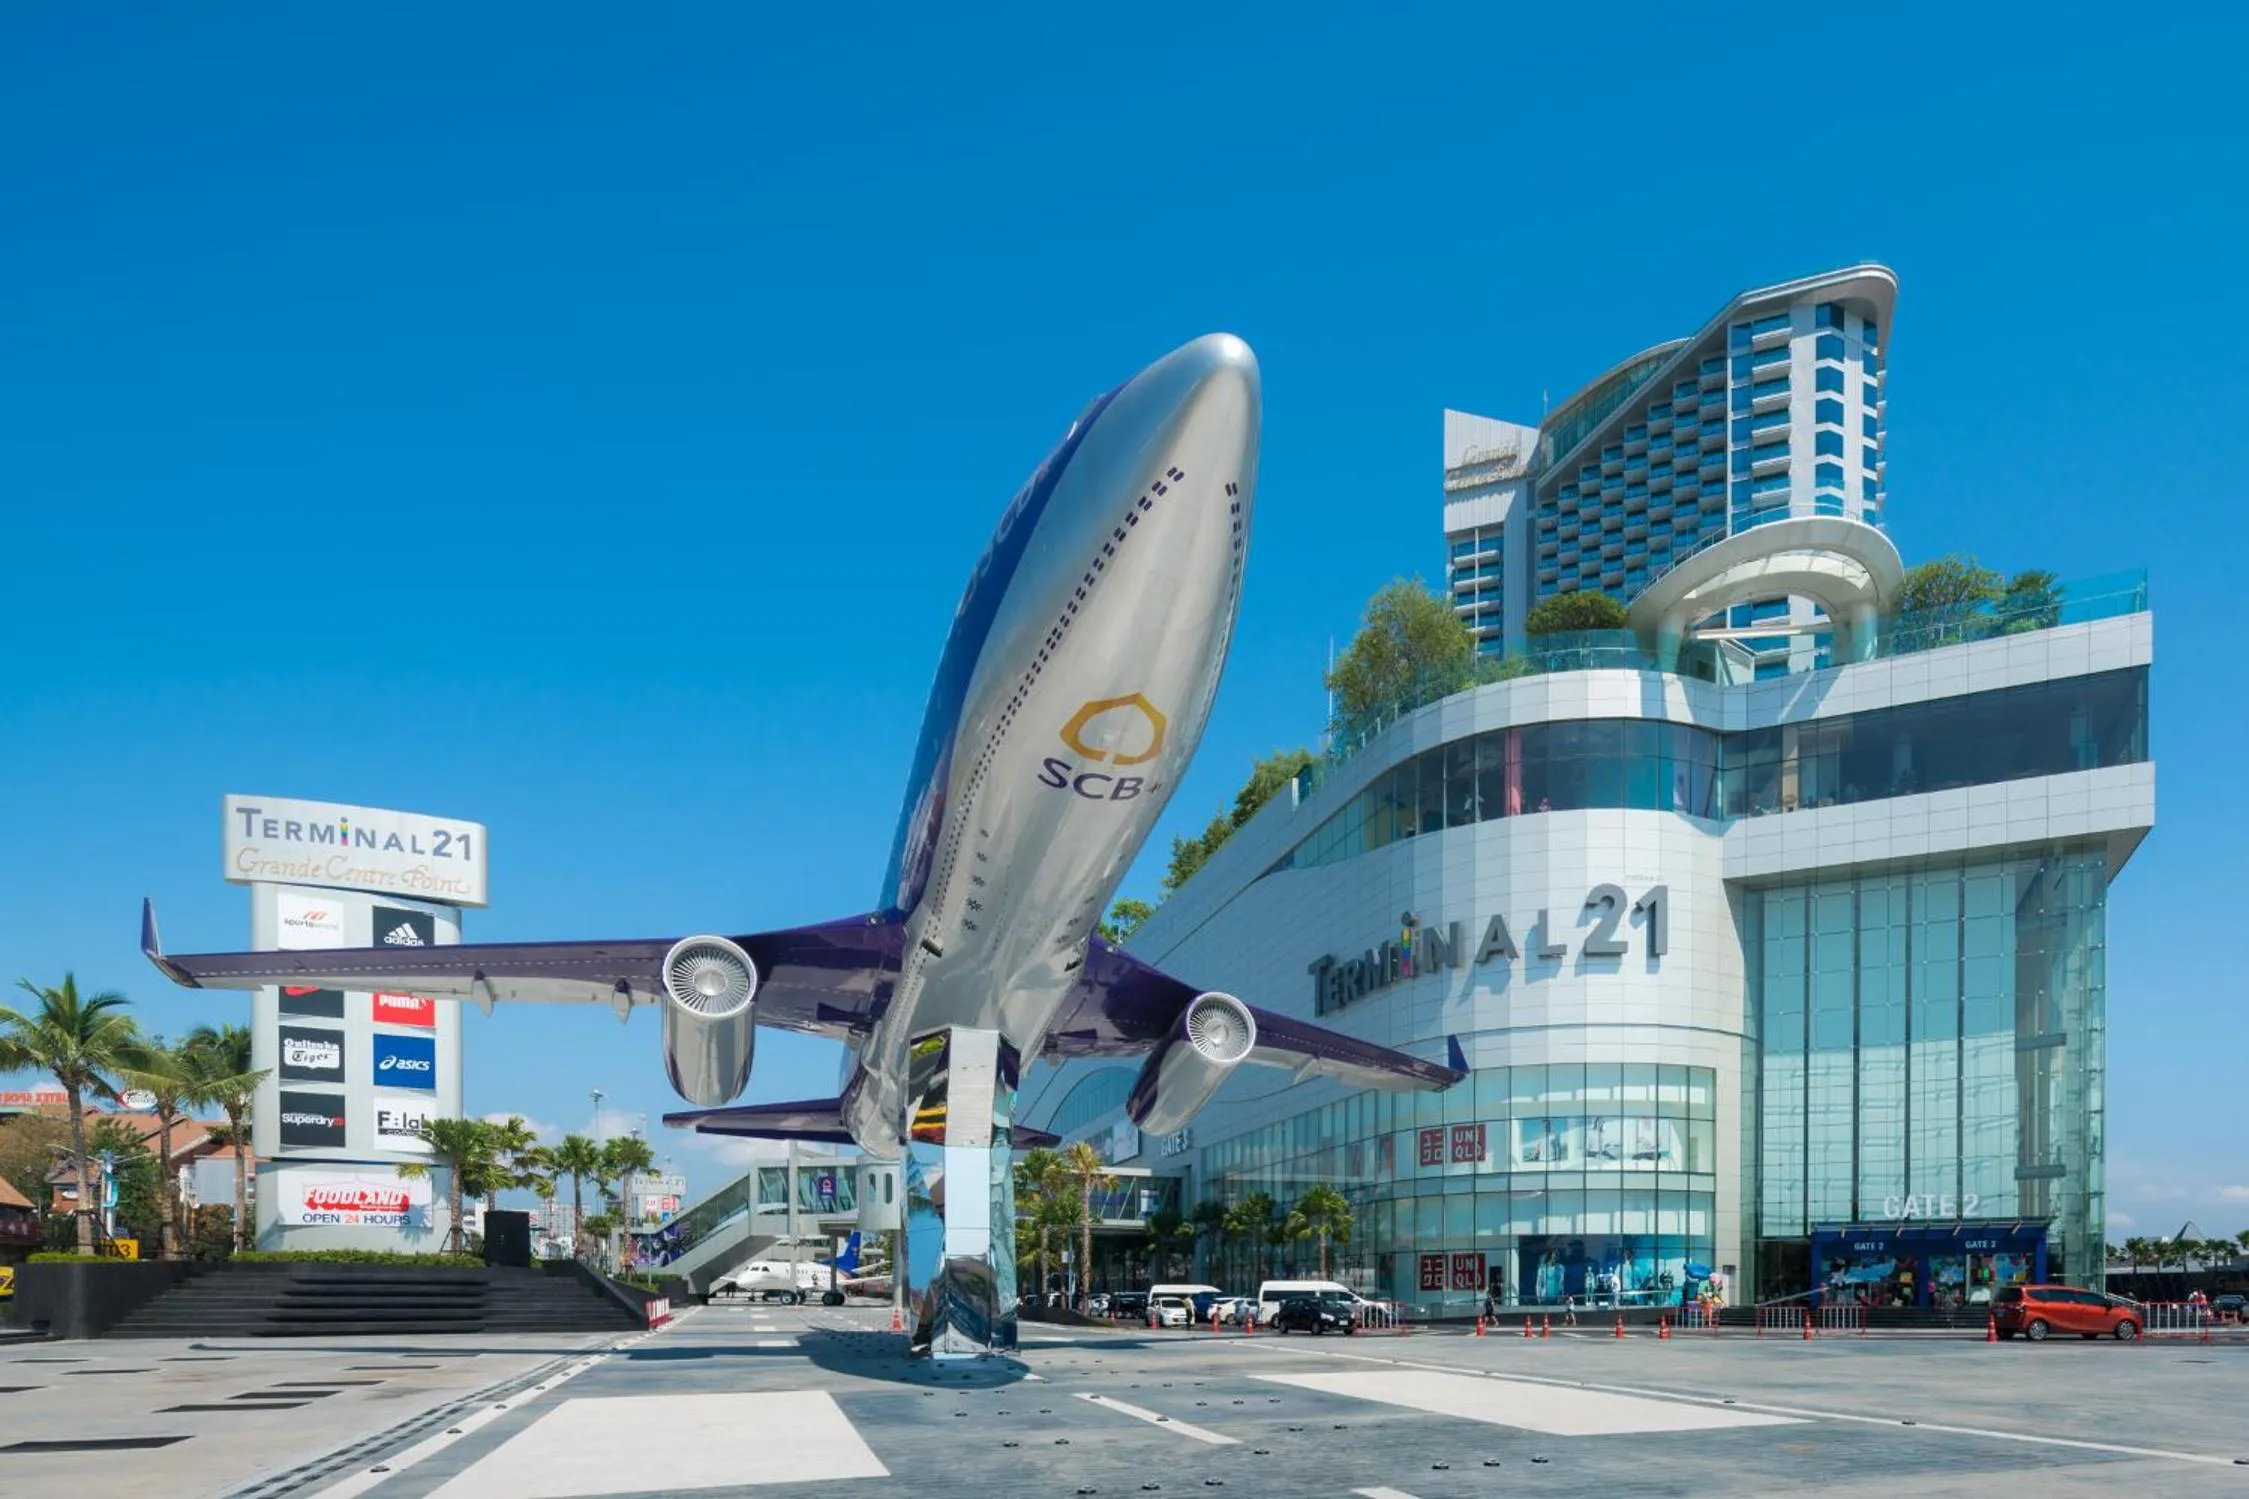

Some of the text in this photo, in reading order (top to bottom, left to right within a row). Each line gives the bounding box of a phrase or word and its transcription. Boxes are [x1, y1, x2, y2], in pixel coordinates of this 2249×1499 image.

[1037, 757, 1144, 801] SCB
[236, 846, 471, 895] Grande Centre Point
[383, 935, 425, 947] adidas
[281, 1112, 334, 1127] Superdry
[1455, 1144, 1482, 1160] QLO
[304, 1188, 408, 1209] FOODLAND
[1884, 1193, 1980, 1218] GATE 2
[302, 1213, 412, 1225] OPEN 24 HOURS
[1854, 1242, 1884, 1250] GATE 2
[1965, 1240, 1996, 1249] GATE 2
[1456, 1273, 1482, 1288] QLO
